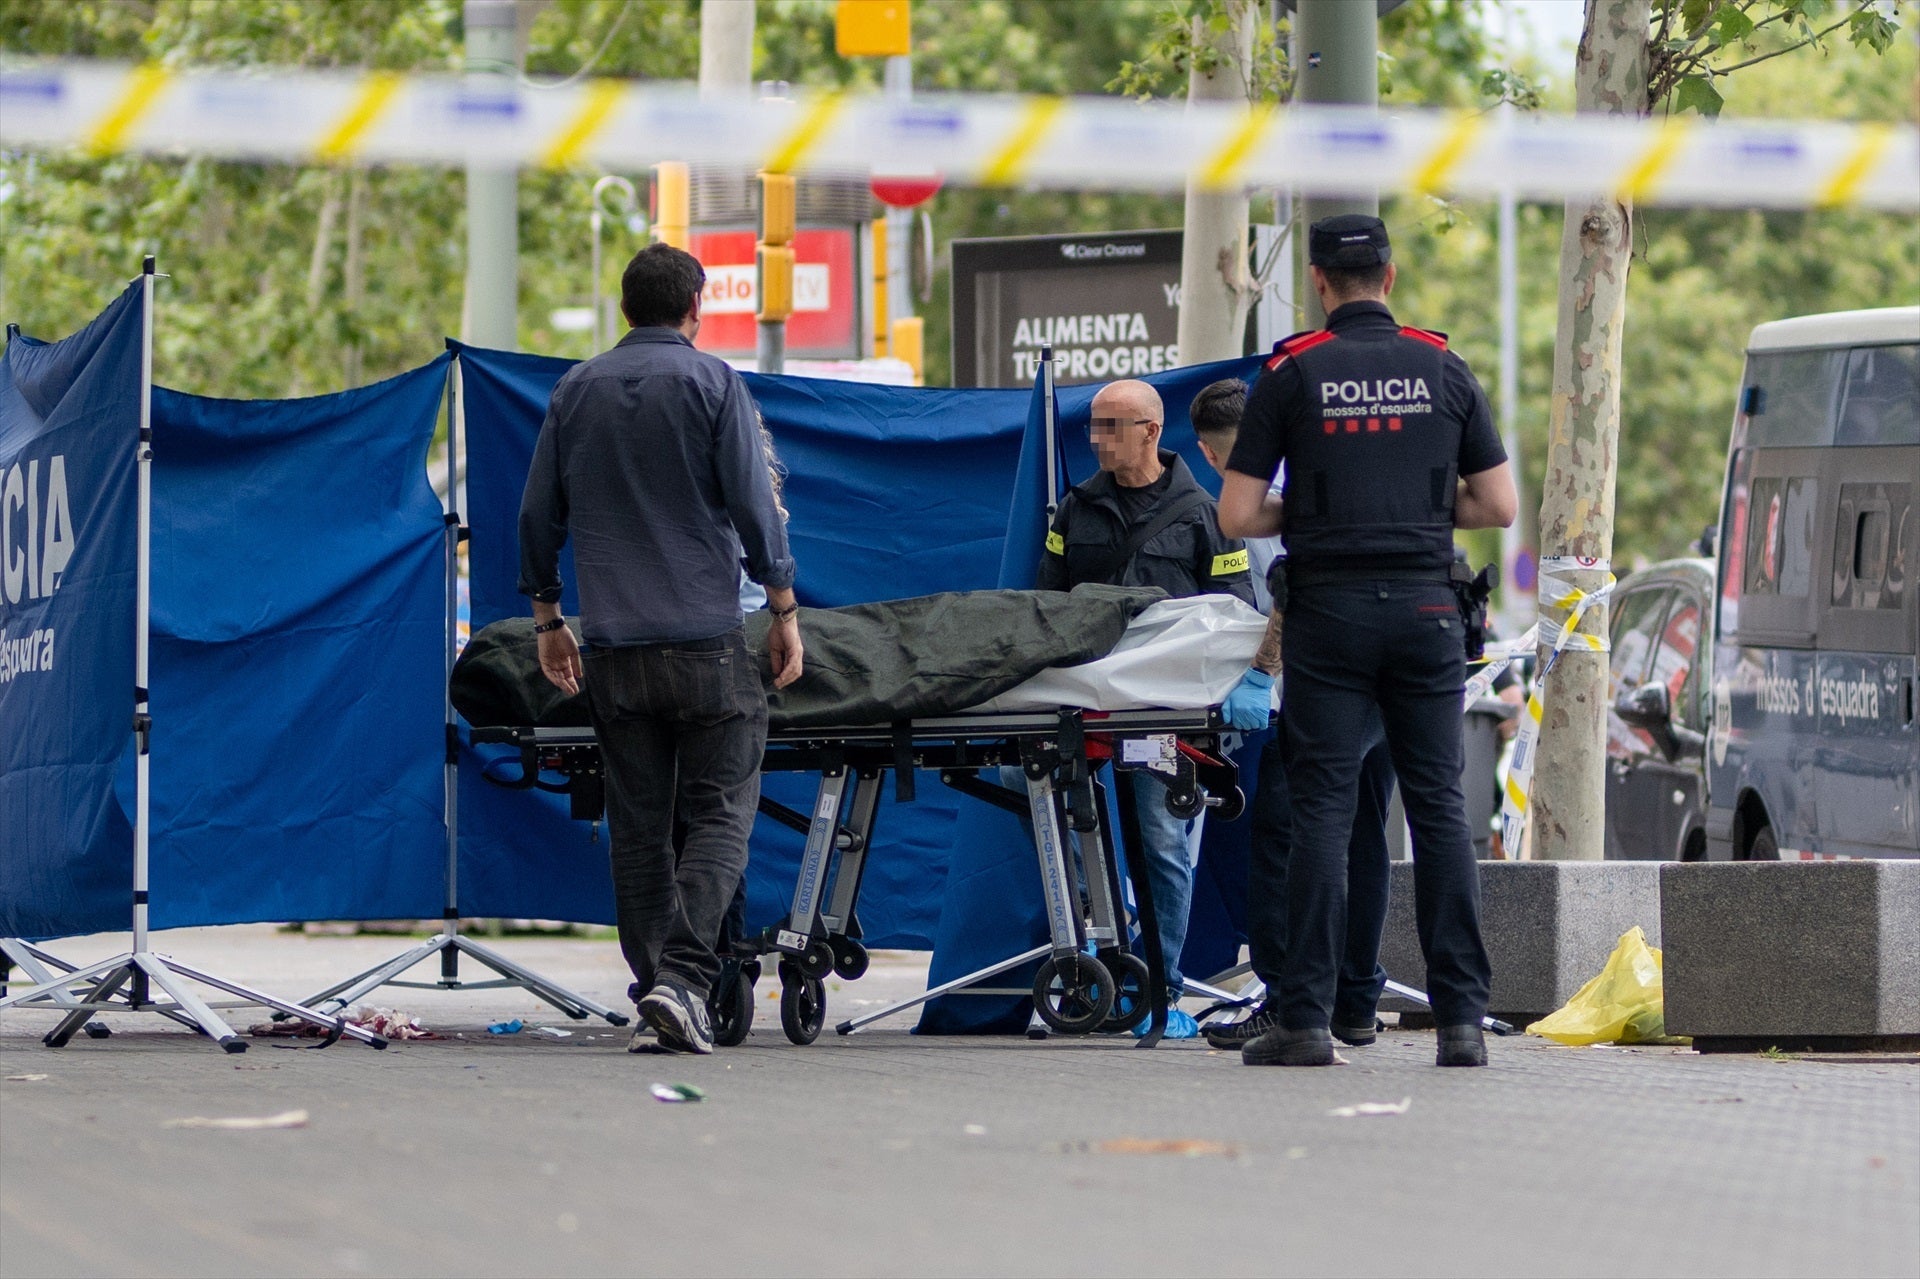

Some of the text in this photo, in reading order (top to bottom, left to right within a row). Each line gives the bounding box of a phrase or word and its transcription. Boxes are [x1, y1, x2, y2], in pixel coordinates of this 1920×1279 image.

[1077, 243, 1146, 258] Clear Channel
[1012, 312, 1149, 347] ALIMENTA
[1321, 378, 1431, 404] POLICIA
[1323, 401, 1432, 417] mossos d'esquadra
[0, 454, 76, 606] CIA
[1756, 676, 1800, 715] mossos
[800, 854, 821, 913] KARTSANA
[1043, 830, 1054, 865] TGF
[1049, 867, 1061, 901] 241
